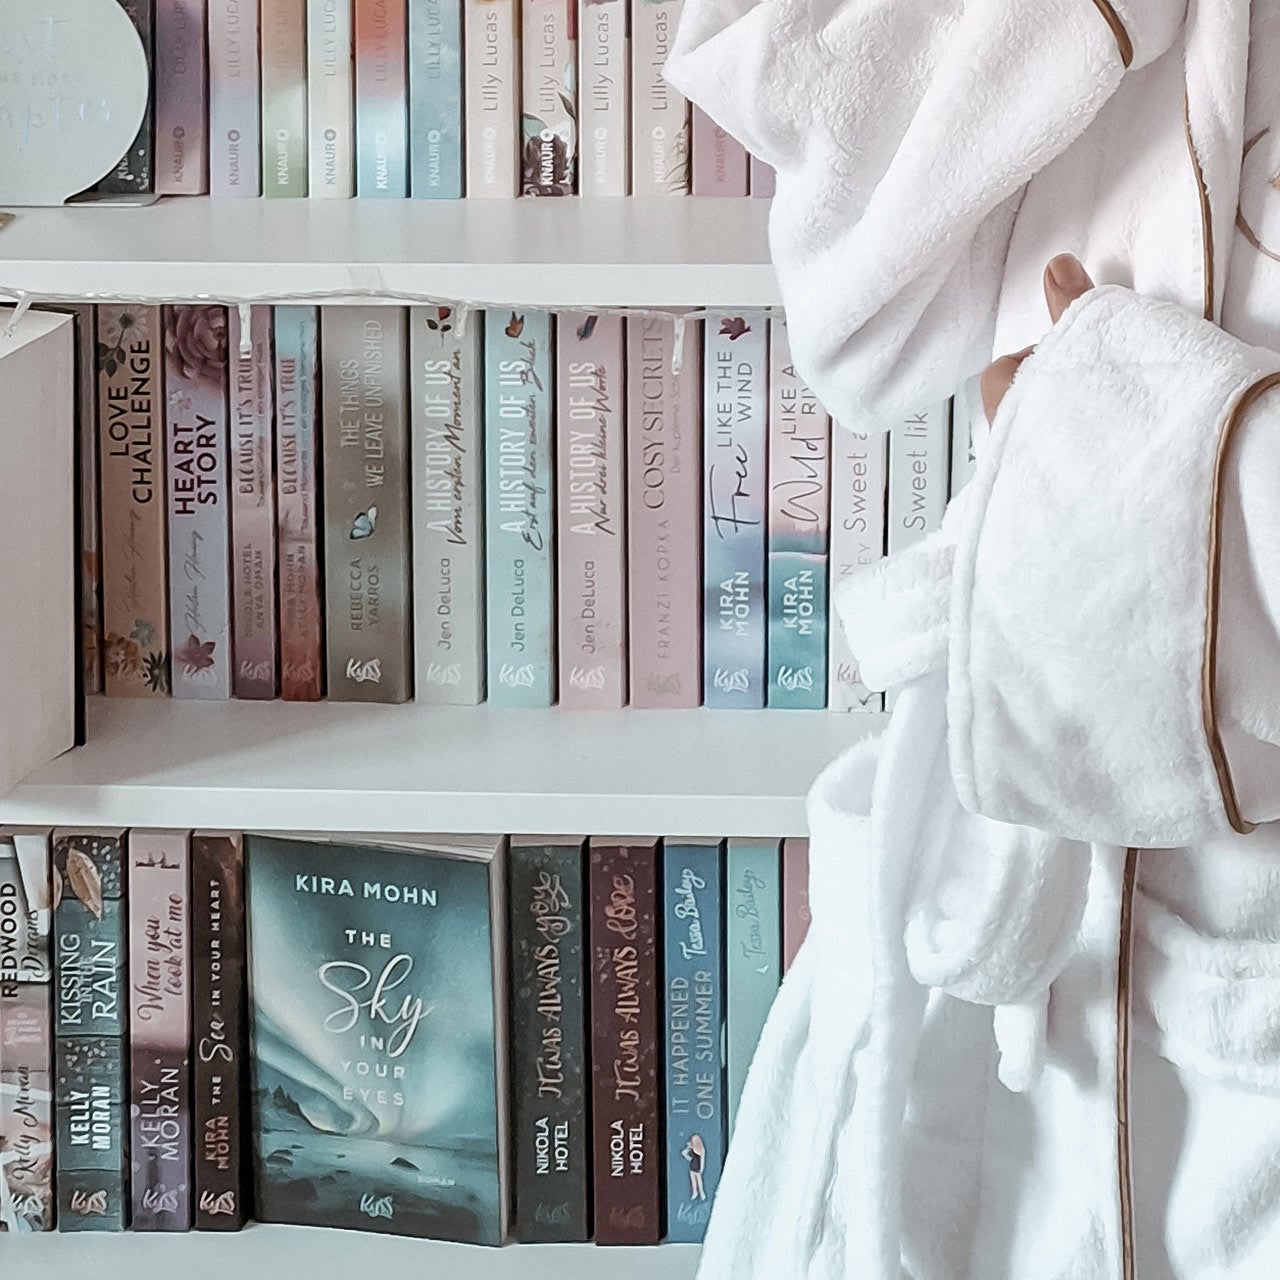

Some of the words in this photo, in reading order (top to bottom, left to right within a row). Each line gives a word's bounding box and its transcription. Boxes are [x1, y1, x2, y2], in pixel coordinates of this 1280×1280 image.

[481, 11, 498, 66] Lucas
[482, 73, 501, 112] Lilly
[717, 351, 733, 393] THE
[736, 361, 753, 423] WIND
[108, 386, 130, 457] LOVE
[130, 339, 153, 504] CHALLENGE
[717, 401, 733, 447] LIKE
[173, 423, 195, 516] HEART
[197, 413, 217, 505] STORY
[709, 443, 760, 540] Free
[844, 451, 868, 533] Sweet
[719, 577, 734, 631] KIRA
[734, 571, 749, 636] MOHN
[295, 874, 355, 898] KIRA
[363, 882, 438, 906] MOHN
[1, 883, 18, 998] REDWOOD
[144, 916, 169, 953] you
[344, 929, 393, 949] THE
[60, 934, 82, 1025] KISSING
[92, 939, 117, 1020] RAIN
[136, 959, 164, 1021] When
[318, 953, 436, 1058] Sky
[671, 977, 689, 1085] HAPPENED
[695, 970, 713, 1062] SUMMER
[340, 1061, 406, 1079] YOUR
[343, 1087, 405, 1106] EYES
[697, 1072, 714, 1120] ONE
[70, 1090, 88, 1146] KELLY
[93, 1086, 111, 1150] MORAN
[140, 1080, 160, 1148] KELLY
[160, 1067, 180, 1161] MORAN
[672, 1097, 687, 1113] IT
[535, 1117, 549, 1174] NIKOLA
[554, 1120, 569, 1171] HOTEL
[609, 1119, 625, 1177] NIKOLA
[629, 1123, 644, 1174] HOTEL
